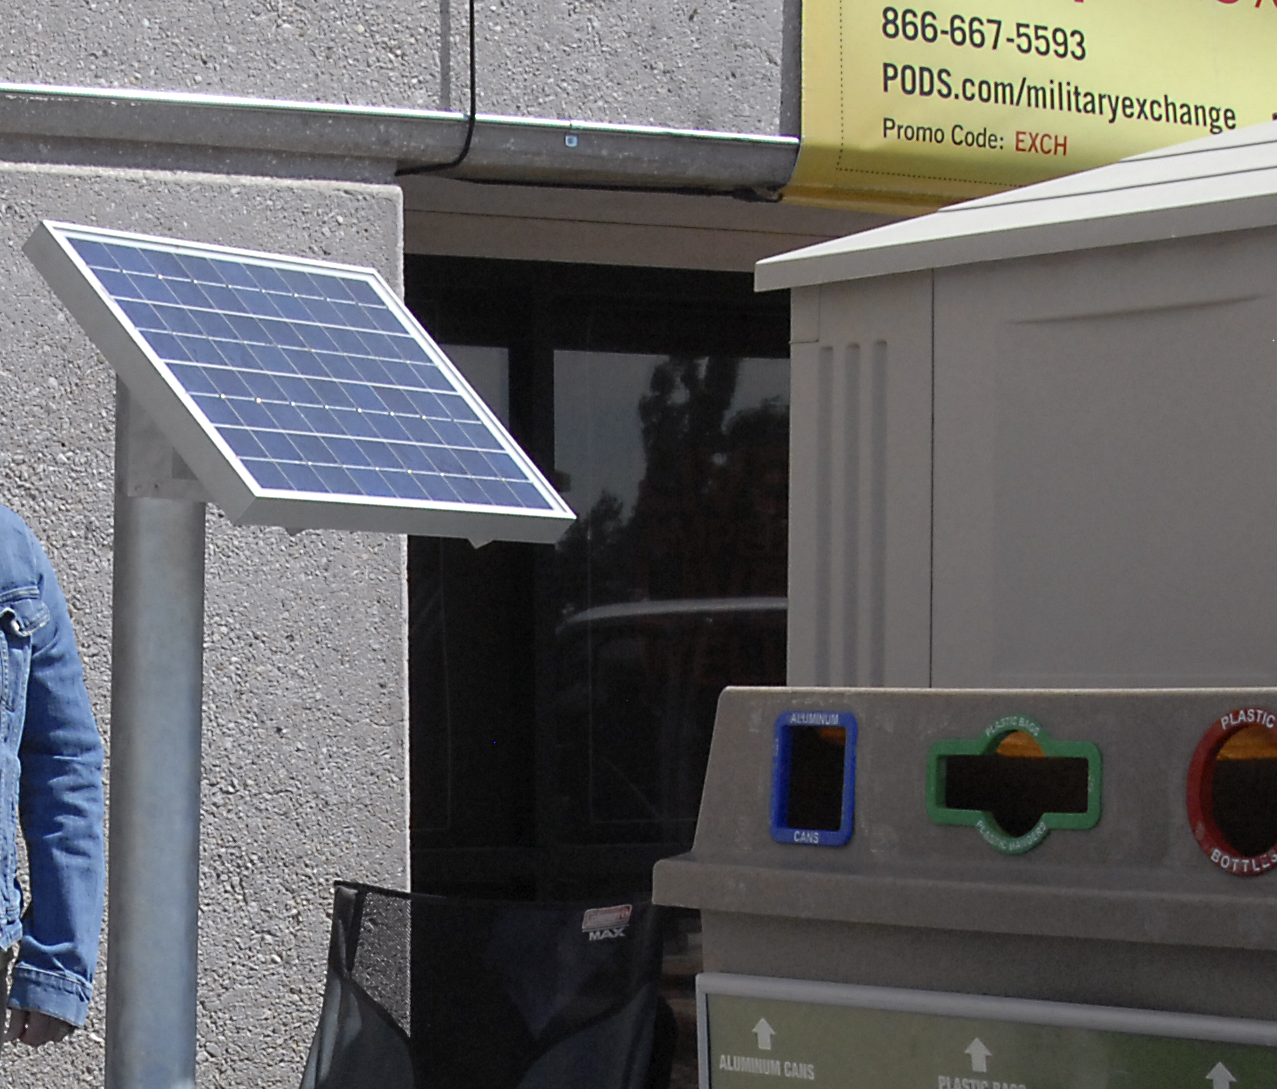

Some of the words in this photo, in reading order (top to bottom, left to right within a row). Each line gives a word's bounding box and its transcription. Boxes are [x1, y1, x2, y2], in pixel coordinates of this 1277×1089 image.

[881, 6, 1086, 61] 866-667-5593
[882, 62, 1237, 135] PODS.com/militaryexchange
[883, 117, 945, 144] Promo
[951, 124, 1004, 150] Code:
[1014, 130, 1068, 156] EXCH
[789, 713, 839, 725] ALUMINUM
[986, 716, 1017, 737] PLASTIC
[1018, 717, 1040, 737] BAGS
[1221, 708, 1276, 730] PLASTIC
[793, 830, 819, 844] CANS
[588, 927, 626, 941] MAX
[719, 1054, 780, 1076] ALUMINUM
[783, 1061, 815, 1080] CANS
